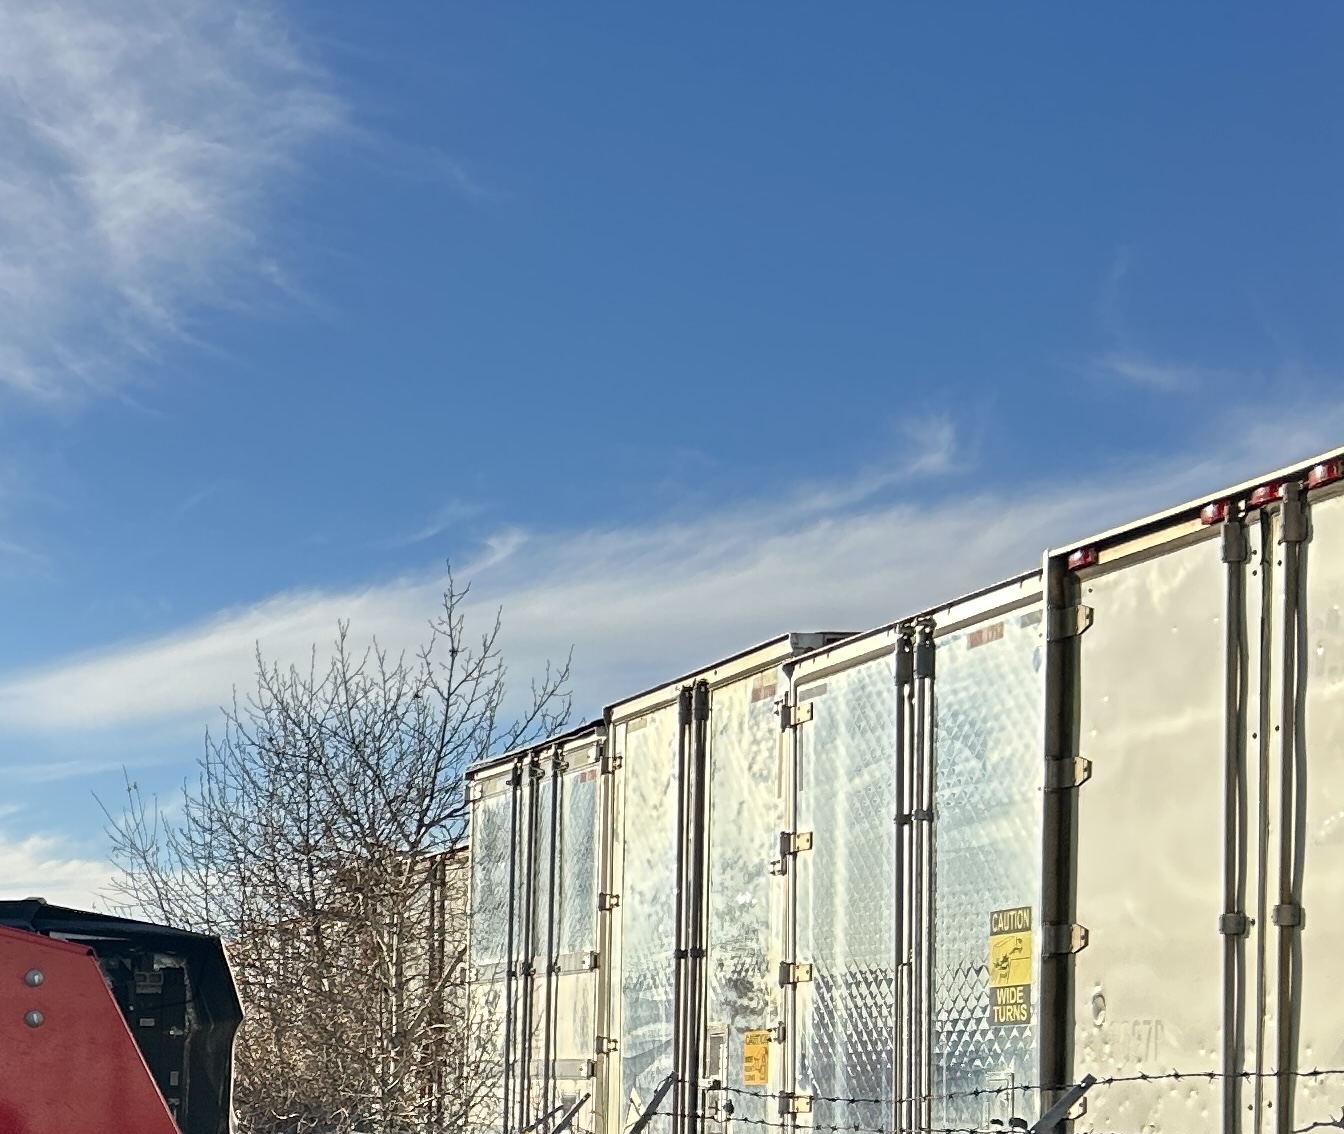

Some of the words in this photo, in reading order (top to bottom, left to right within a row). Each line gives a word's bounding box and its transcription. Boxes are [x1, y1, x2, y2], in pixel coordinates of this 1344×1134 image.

[992, 910, 1031, 932] CAUTION
[996, 986, 1024, 1005] WIDE
[993, 1005, 1028, 1023] TURNS
